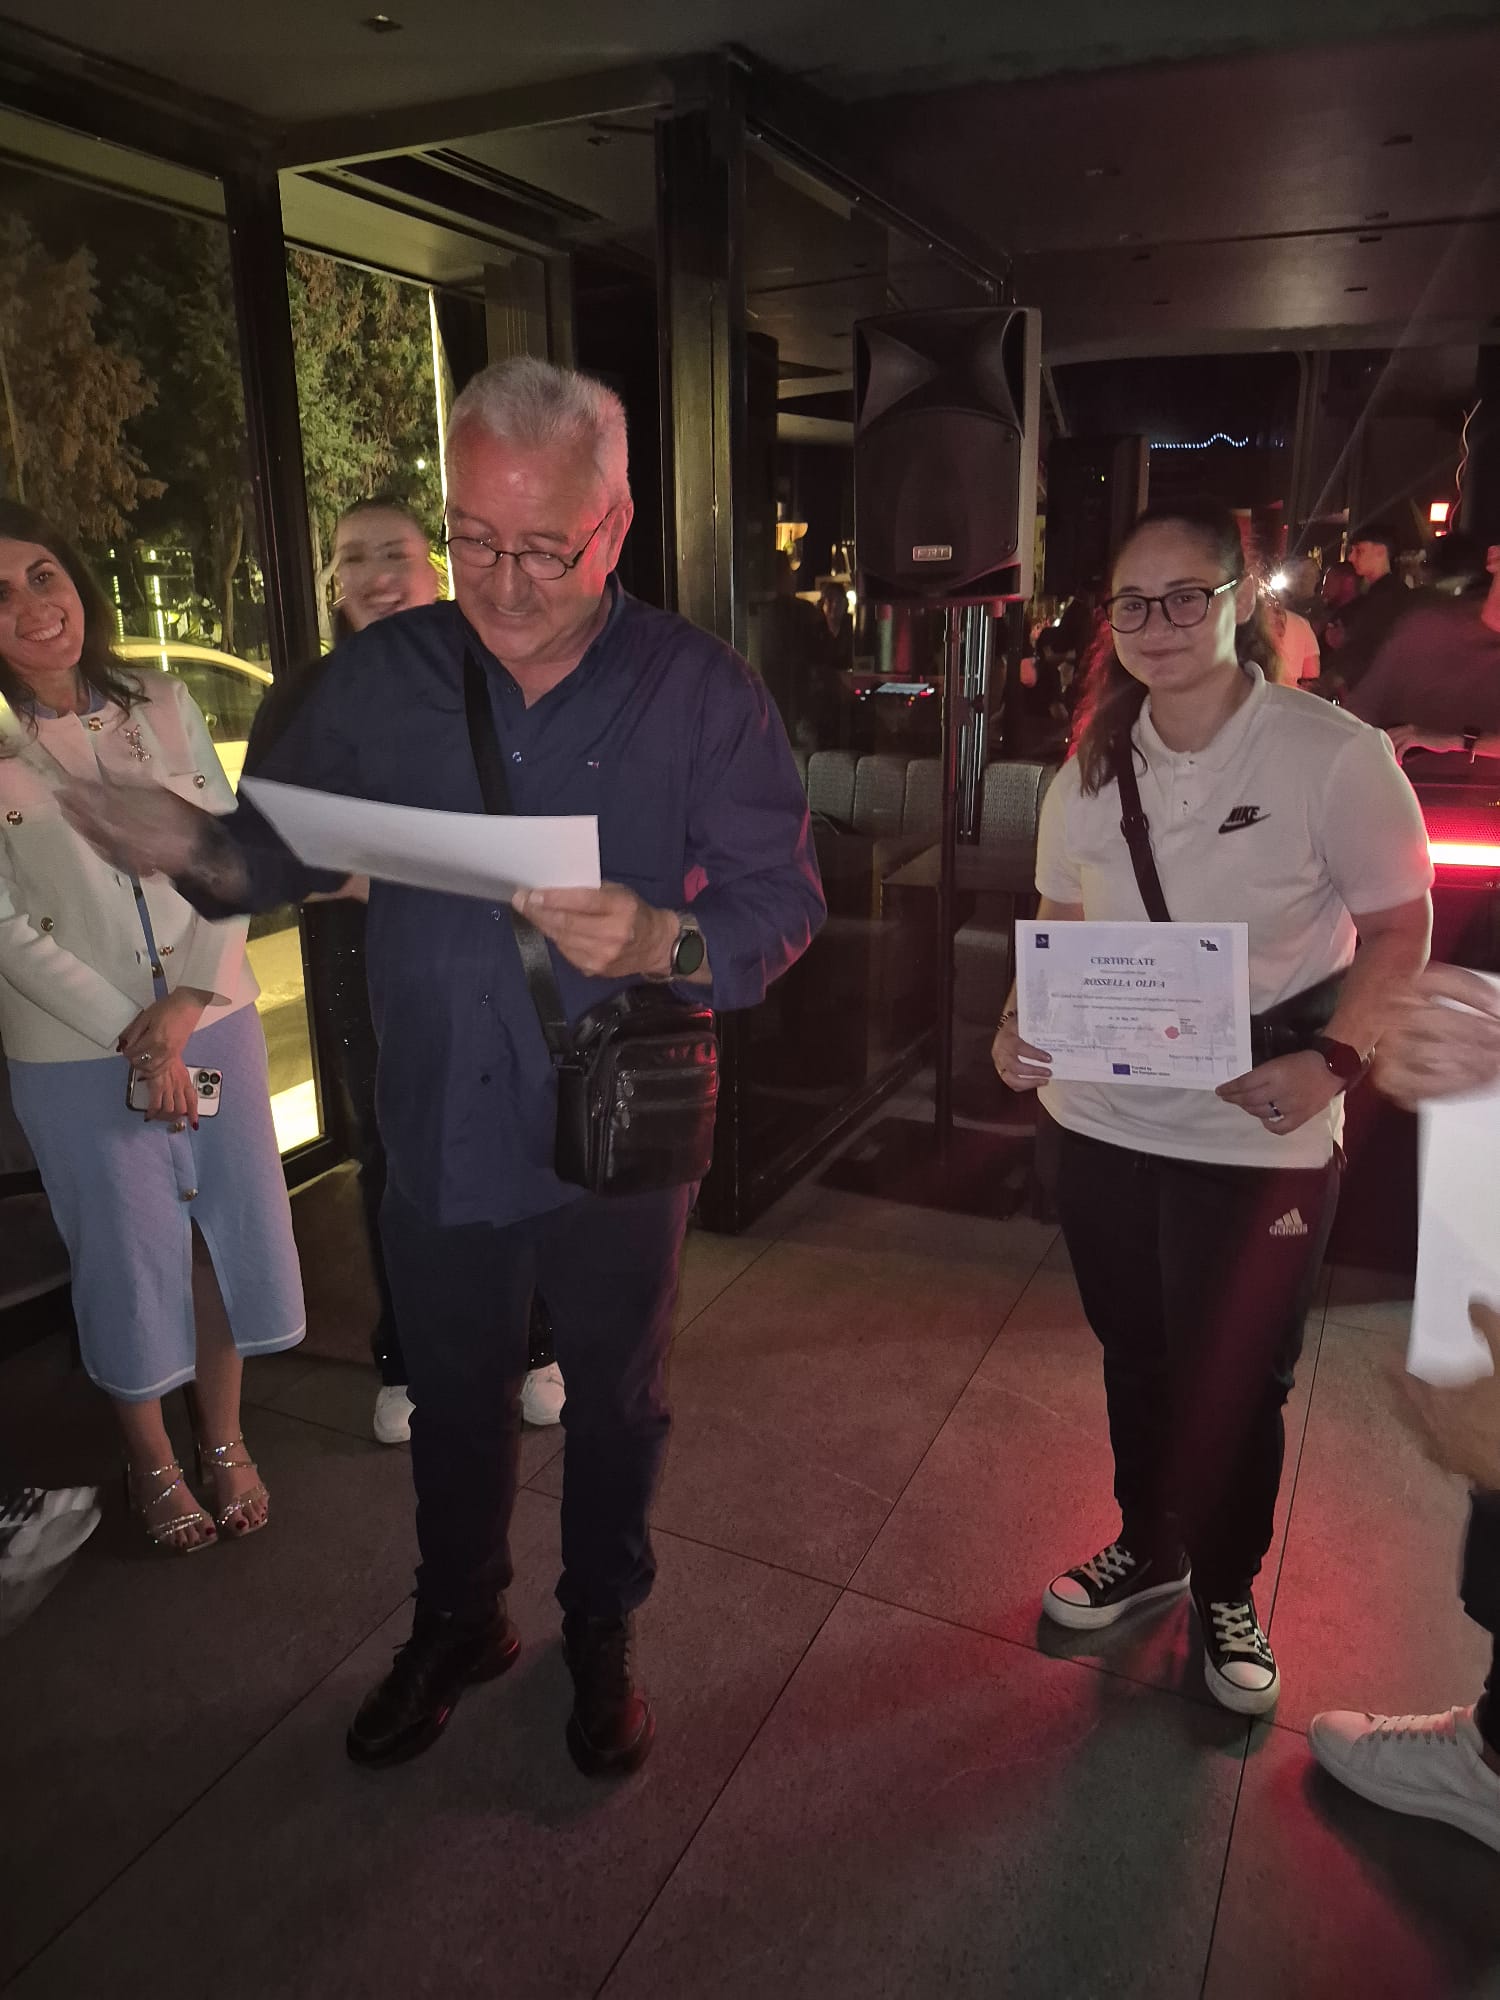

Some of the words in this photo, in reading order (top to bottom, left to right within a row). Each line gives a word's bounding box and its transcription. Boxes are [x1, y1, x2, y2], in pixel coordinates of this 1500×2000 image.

[1225, 805, 1261, 823] NIKE
[1090, 956, 1157, 966] CERTIFICATE
[1083, 978, 1131, 987] ROSSELLA
[1135, 979, 1166, 988] OLIVA
[1269, 1222, 1308, 1236] adidas
